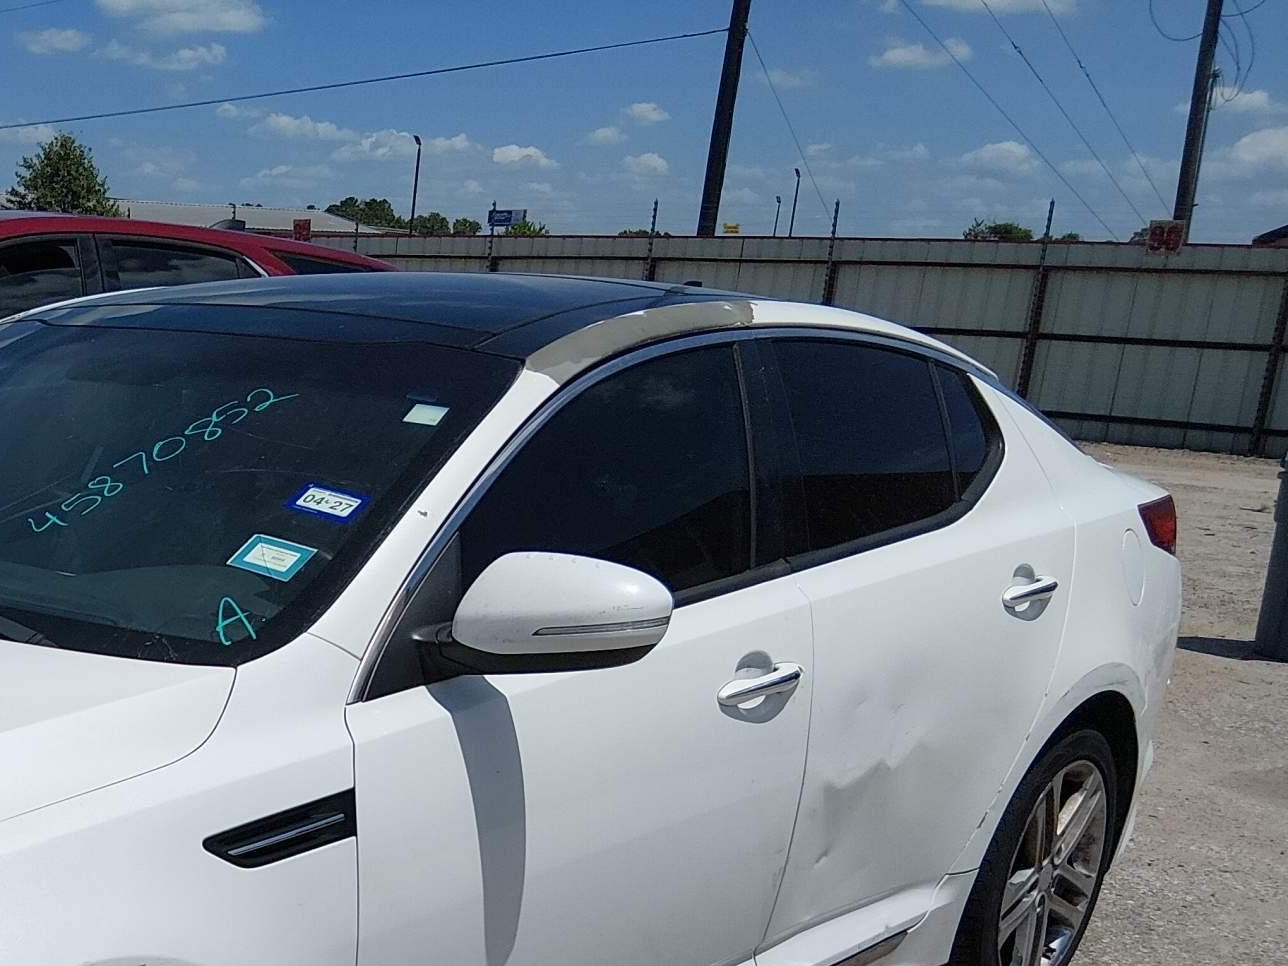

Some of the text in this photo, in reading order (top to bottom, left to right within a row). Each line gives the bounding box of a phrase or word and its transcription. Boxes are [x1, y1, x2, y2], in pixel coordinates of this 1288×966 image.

[28, 388, 299, 533] 45870852
[302, 493, 326, 506] 04
[329, 500, 354, 513] 27
[216, 597, 257, 646] A
